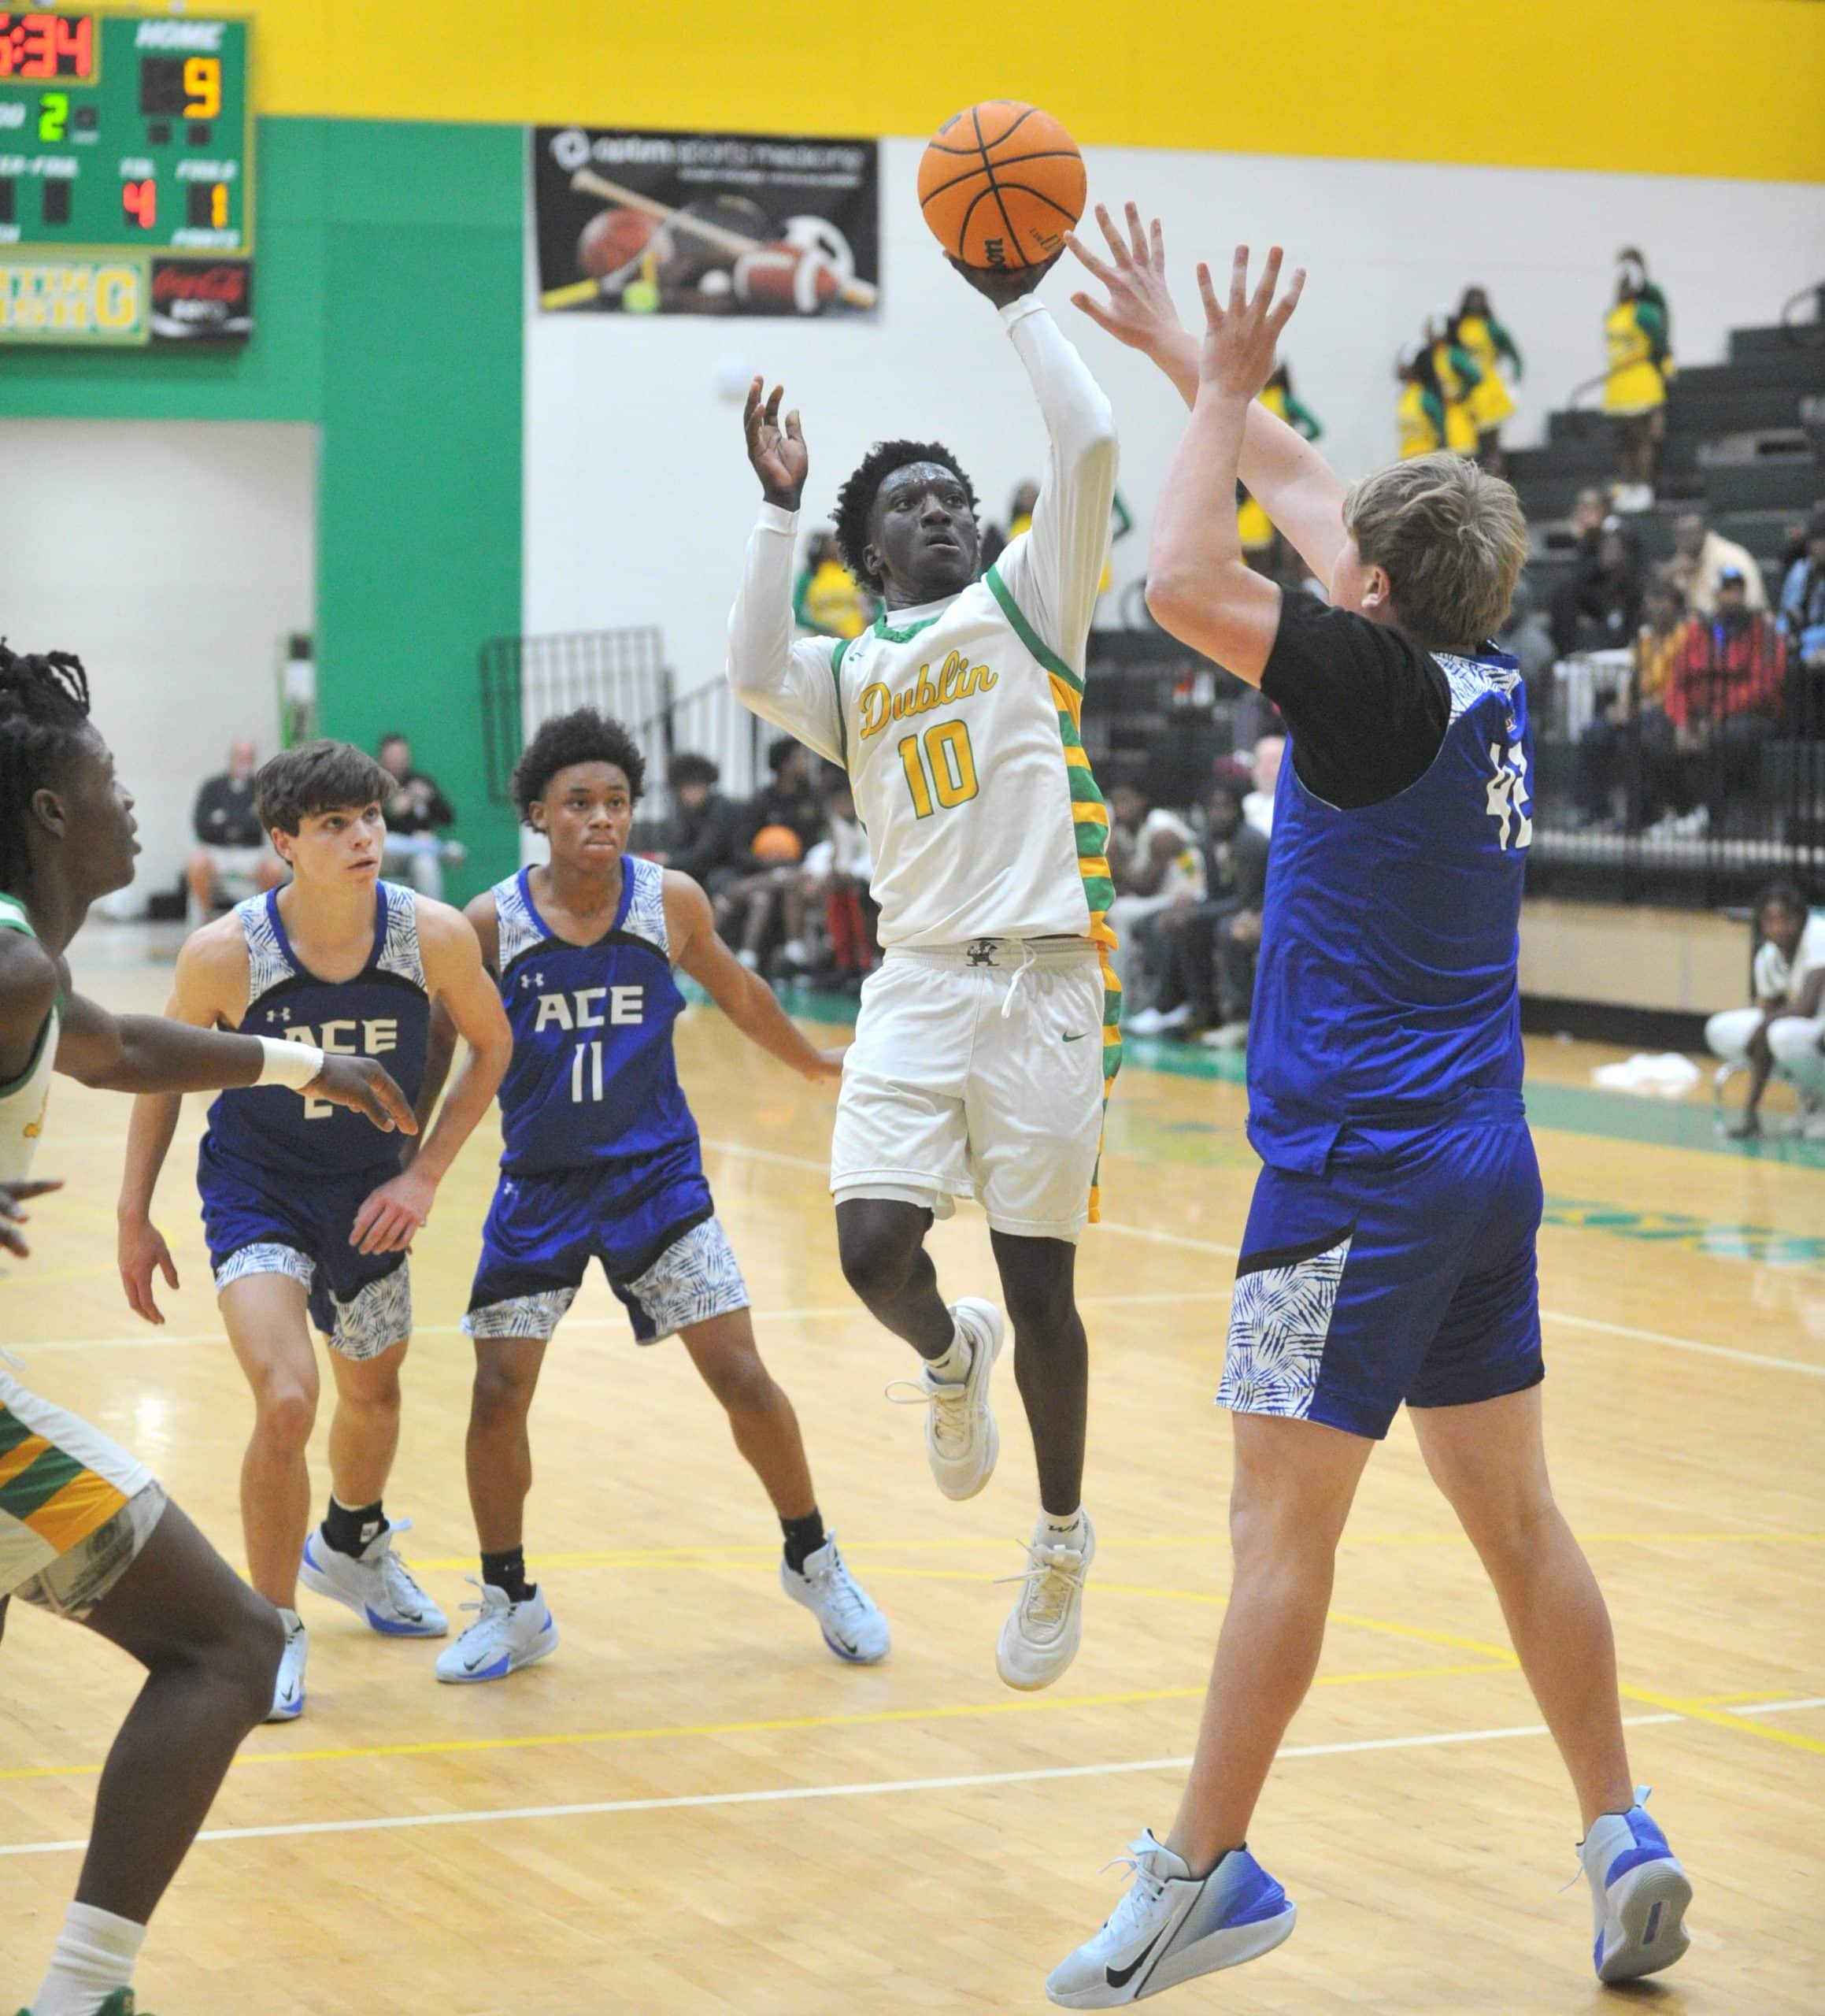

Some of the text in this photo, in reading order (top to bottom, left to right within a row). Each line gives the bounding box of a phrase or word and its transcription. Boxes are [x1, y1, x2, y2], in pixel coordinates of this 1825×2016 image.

[182, 56, 221, 118] 9
[39, 92, 69, 142] 2
[122, 178, 156, 229] 4
[211, 182, 228, 228] 1
[859, 650, 998, 740] Dublin
[898, 719, 979, 820] 10
[535, 985, 643, 1032] ACE
[572, 1042, 603, 1102] 11
